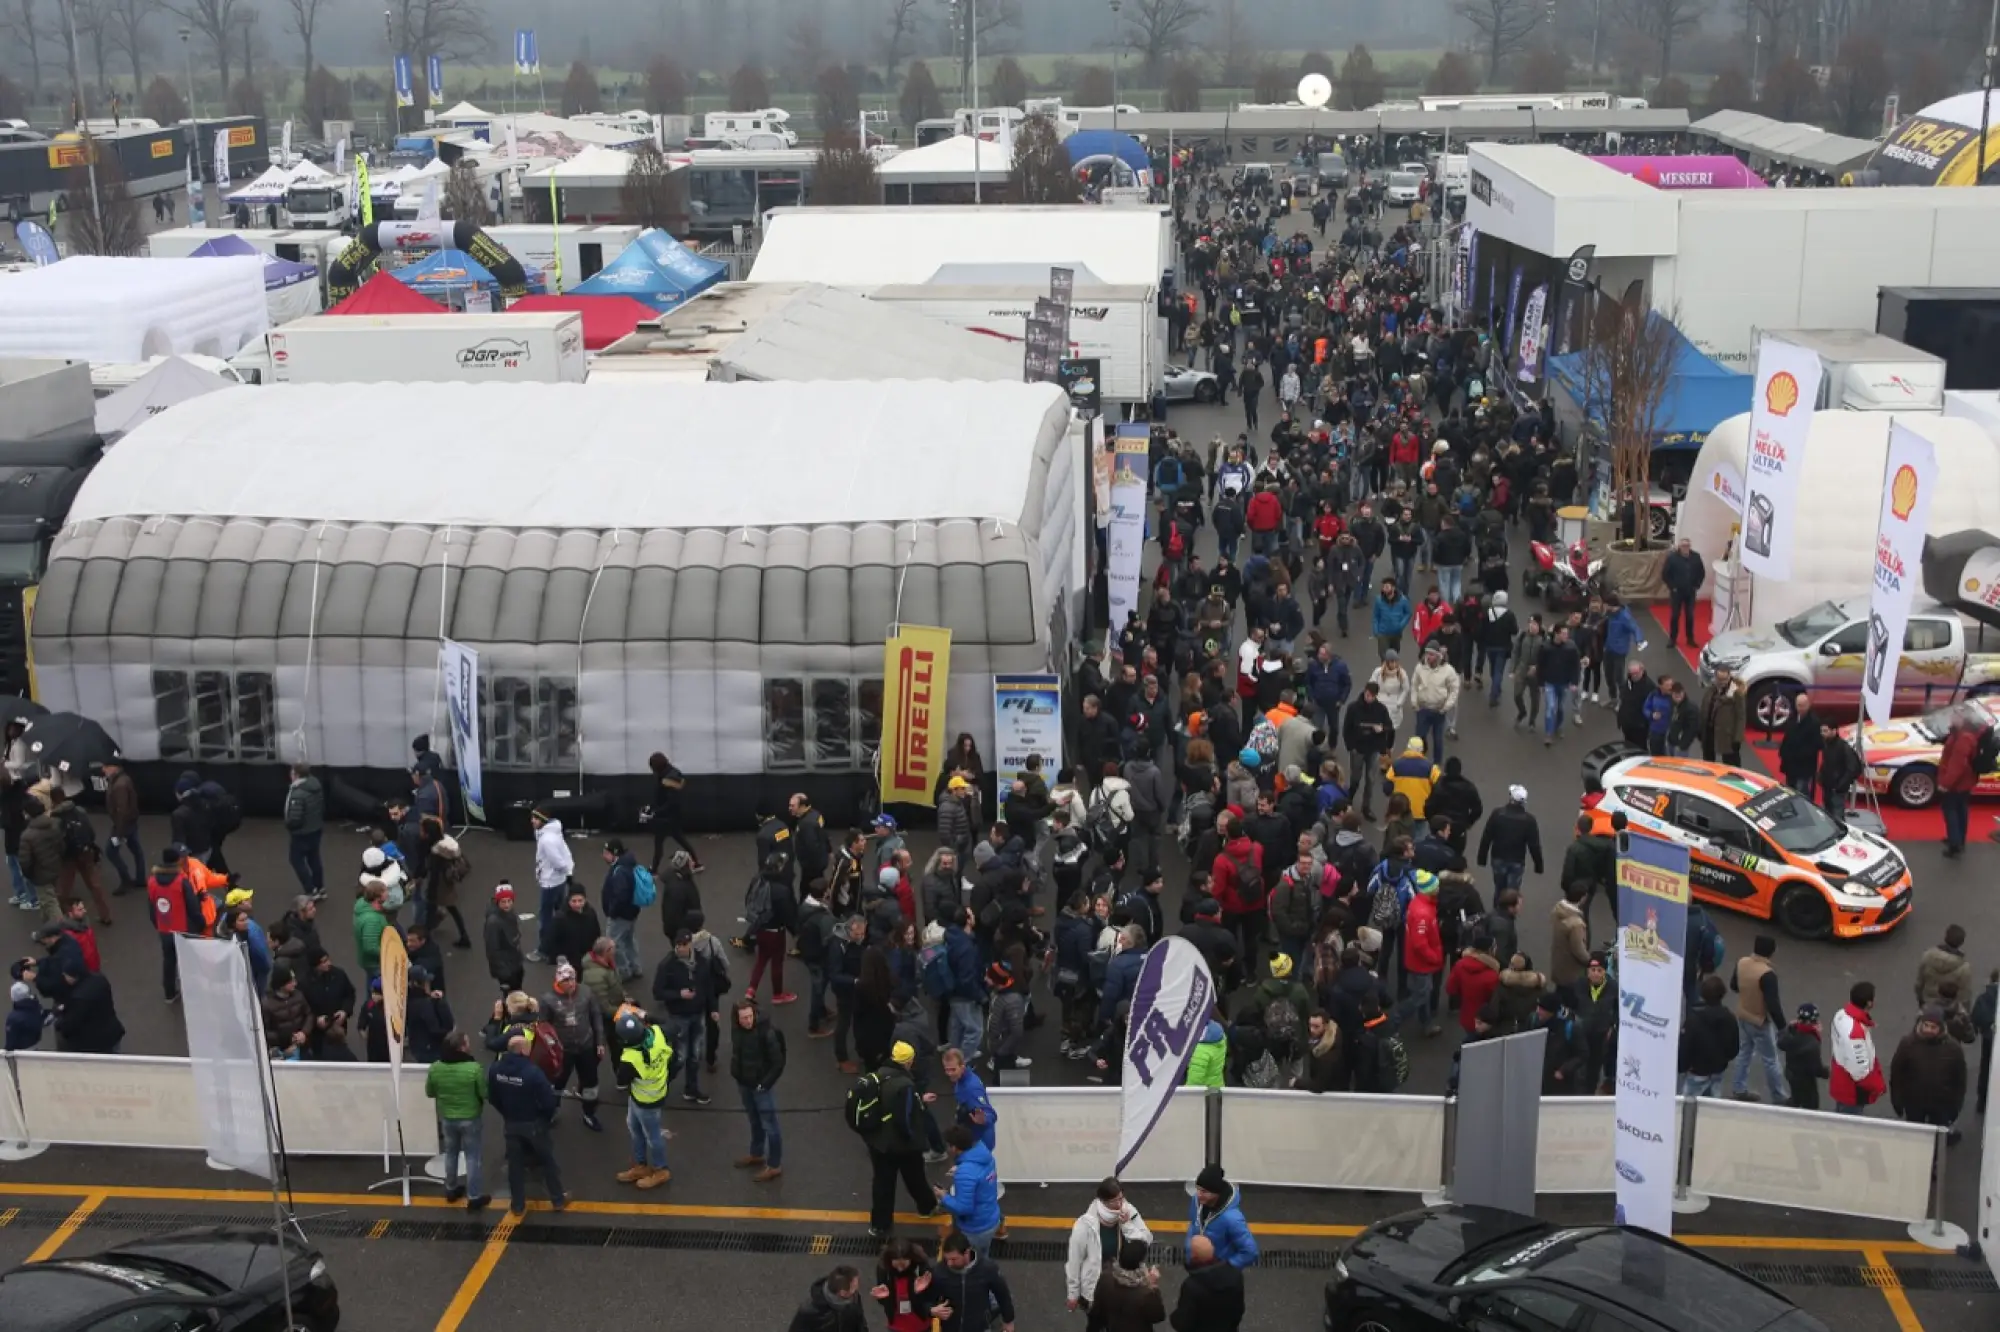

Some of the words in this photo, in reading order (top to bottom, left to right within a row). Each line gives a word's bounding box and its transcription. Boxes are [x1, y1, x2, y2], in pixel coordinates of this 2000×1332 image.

[1659, 172, 1713, 185] MESSERI
[1522, 302, 1536, 338] TEAM
[464, 349, 499, 361] DGR
[1753, 454, 1783, 472] ULTRA
[1755, 440, 1786, 461] HELIX
[895, 646, 934, 793] PIRELLI
[1653, 793, 1670, 818] 12
[1621, 863, 1681, 897] PIRELLI
[1183, 973, 1206, 1028] RACING
[1129, 1006, 1182, 1089] PR
[1618, 1079, 1660, 1100] UGEOT
